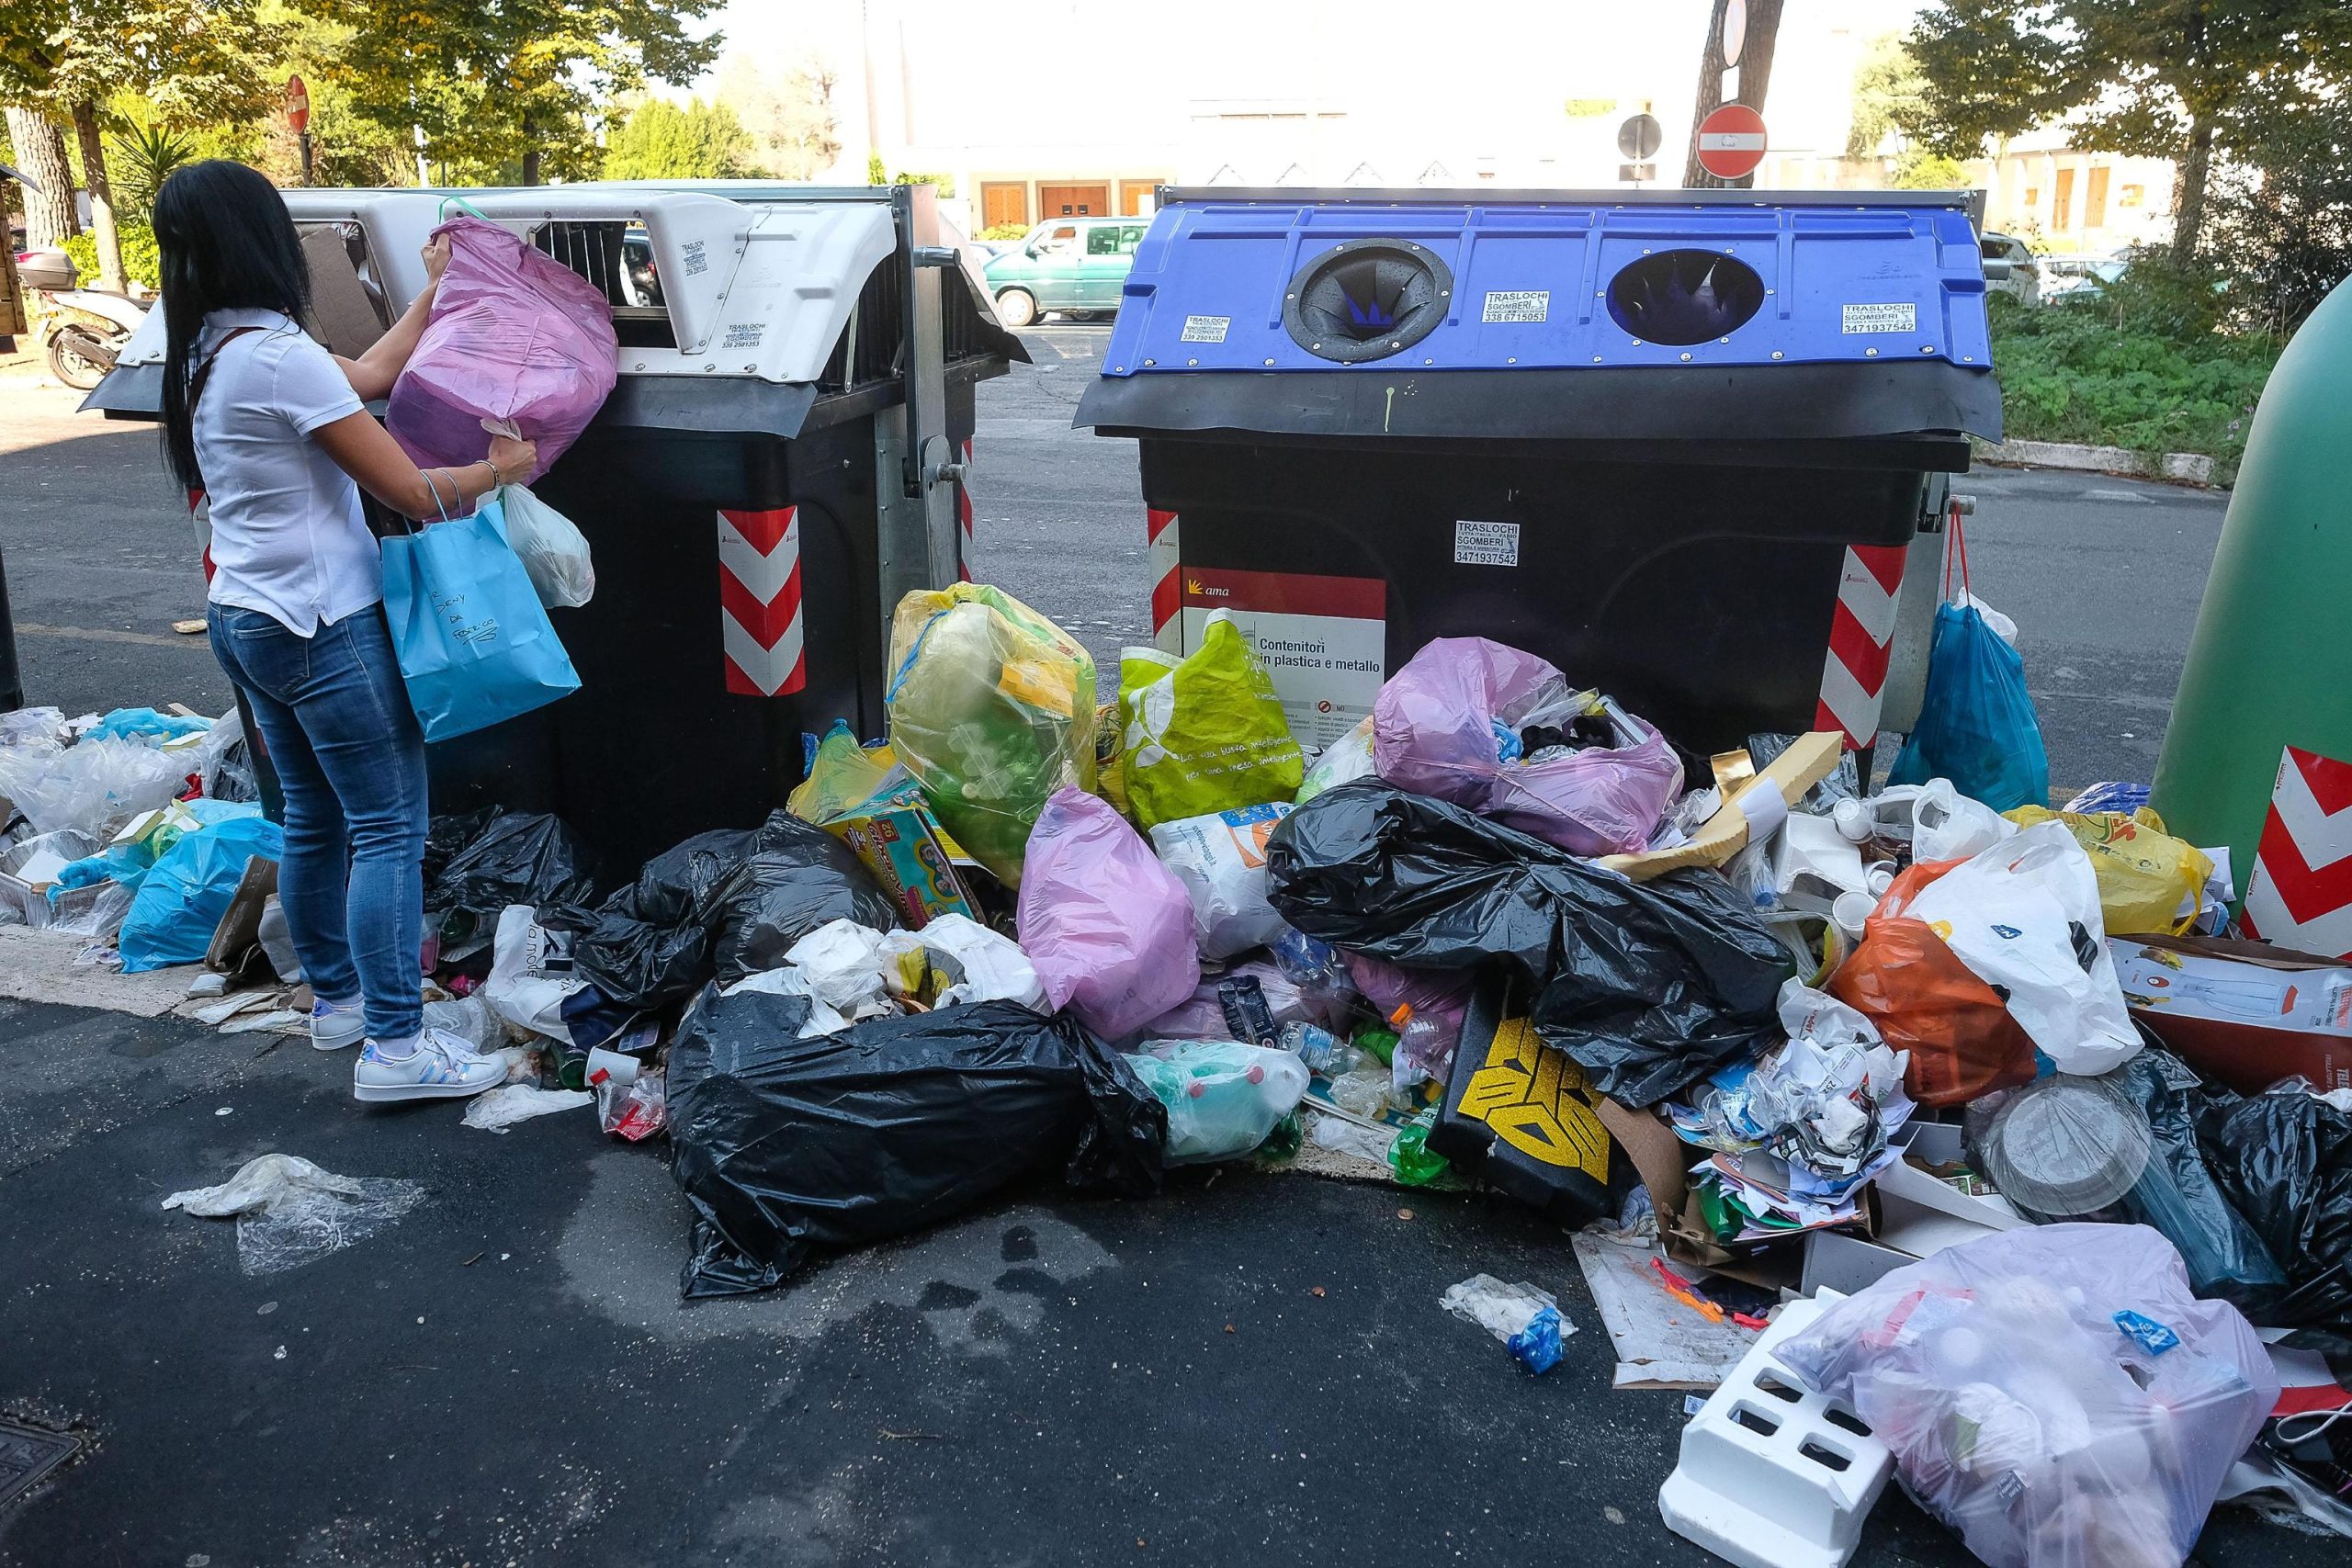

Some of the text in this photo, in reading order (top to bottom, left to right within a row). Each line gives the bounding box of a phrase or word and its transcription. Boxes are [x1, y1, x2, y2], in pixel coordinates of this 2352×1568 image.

[1488, 292, 1548, 303] TRASLOCHI
[1487, 300, 1532, 310] SGOMBERI
[1845, 304, 1914, 312] TRASLOCHI
[1485, 313, 1545, 321] 338 6715053
[1845, 313, 1898, 321] SGOMBERI
[1844, 323, 1914, 333] 3471937542
[1457, 522, 1518, 535] TRASLOCHI
[1457, 536, 1504, 547] SGOMBERI
[1456, 551, 1516, 565] 3471937542
[1205, 587, 1229, 596] ama
[1260, 637, 1325, 653] Contenitori
[1260, 652, 1380, 672] in plastica e metallo
[1180, 752, 1194, 763] La
[1220, 744, 1248, 756] busta
[1250, 735, 1293, 750] intelligente
[1185, 770, 1200, 783] per
[1228, 761, 1254, 773] spesa
[1259, 750, 1303, 766] intelligente
